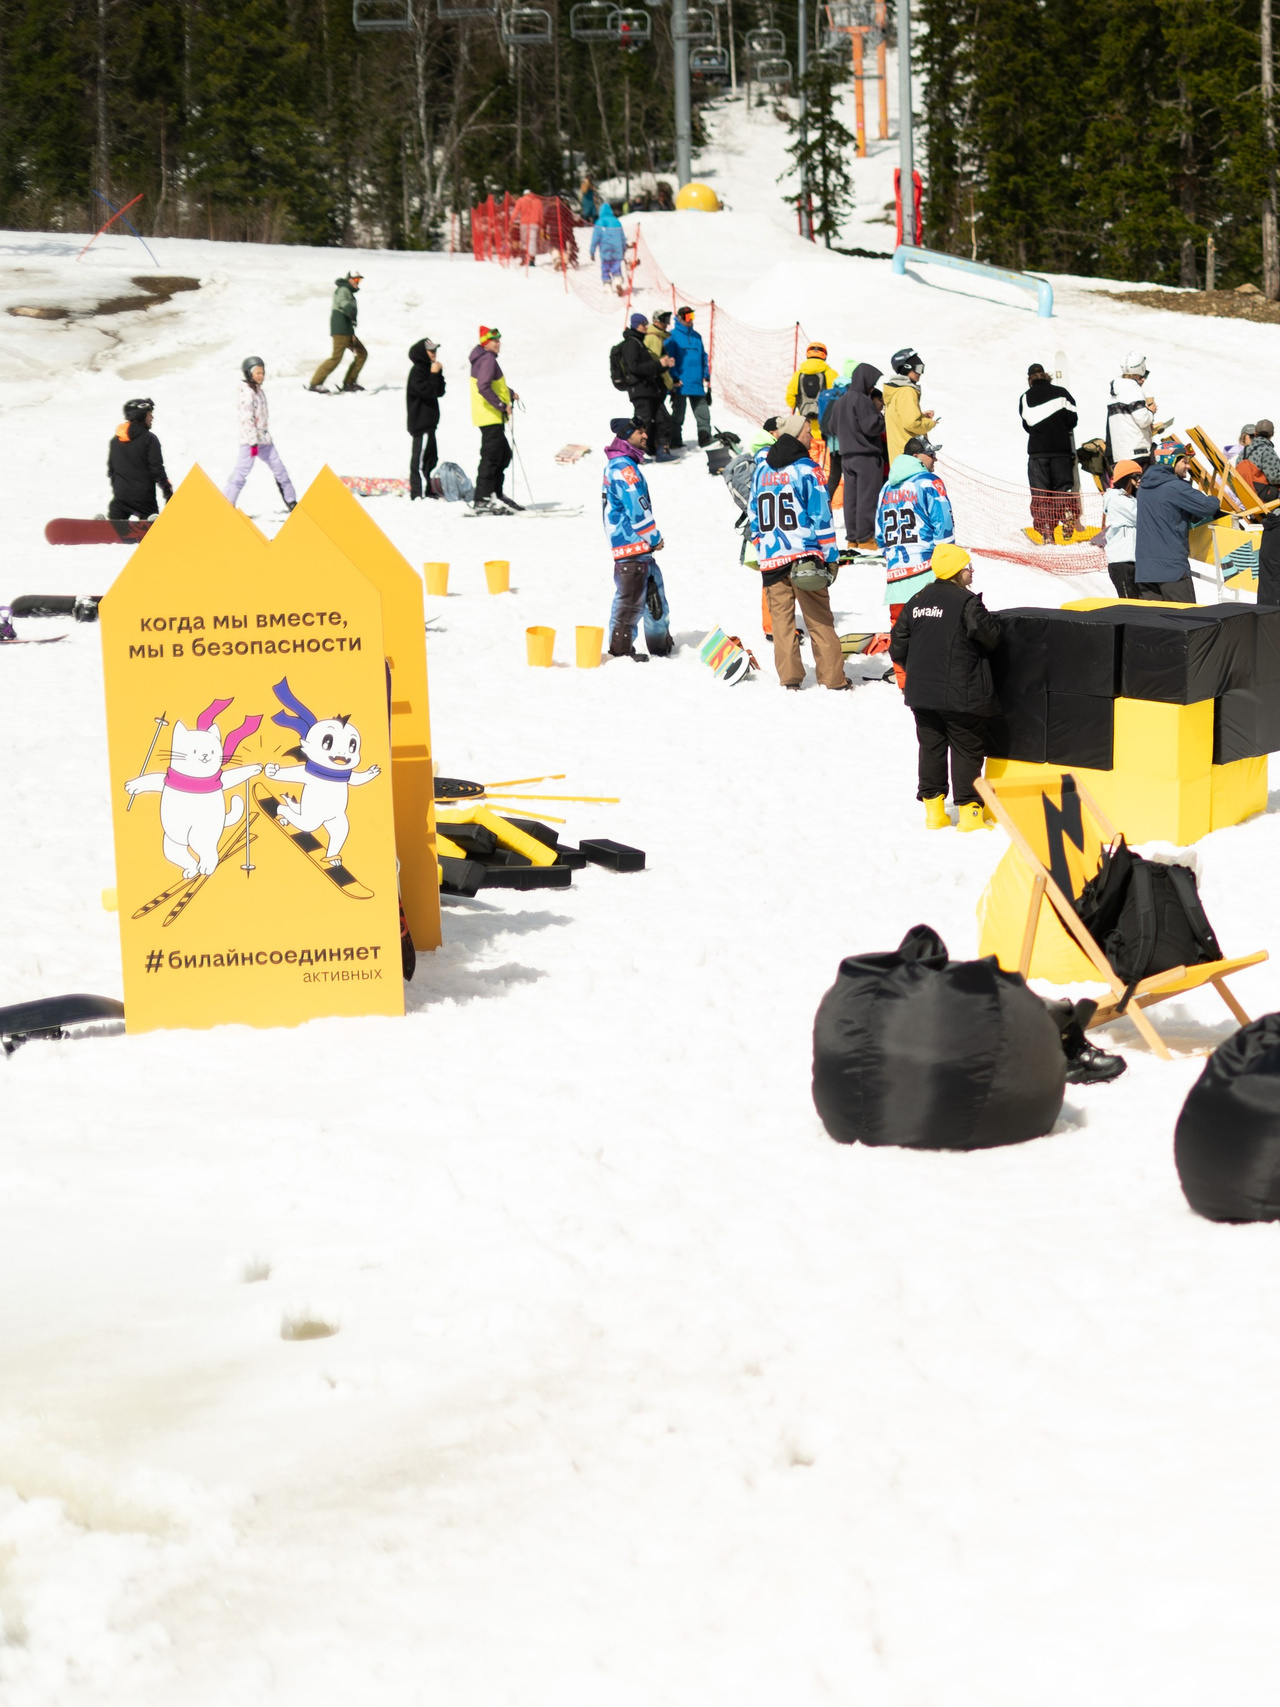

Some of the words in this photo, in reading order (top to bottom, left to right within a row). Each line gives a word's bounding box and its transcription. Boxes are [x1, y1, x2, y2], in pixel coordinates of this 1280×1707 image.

[762, 472, 790, 486] ШЕФ
[881, 489, 918, 506] ОЦМАН
[758, 492, 798, 532] 06
[884, 508, 918, 547] 22
[140, 614, 205, 633] когда
[213, 613, 248, 630] мы
[256, 609, 349, 629] вместе,
[128, 642, 164, 659] мы
[172, 643, 185, 658] в
[191, 636, 362, 657] безопасности
[144, 945, 381, 973] #билайнсоединяет
[302, 968, 383, 983] активных
